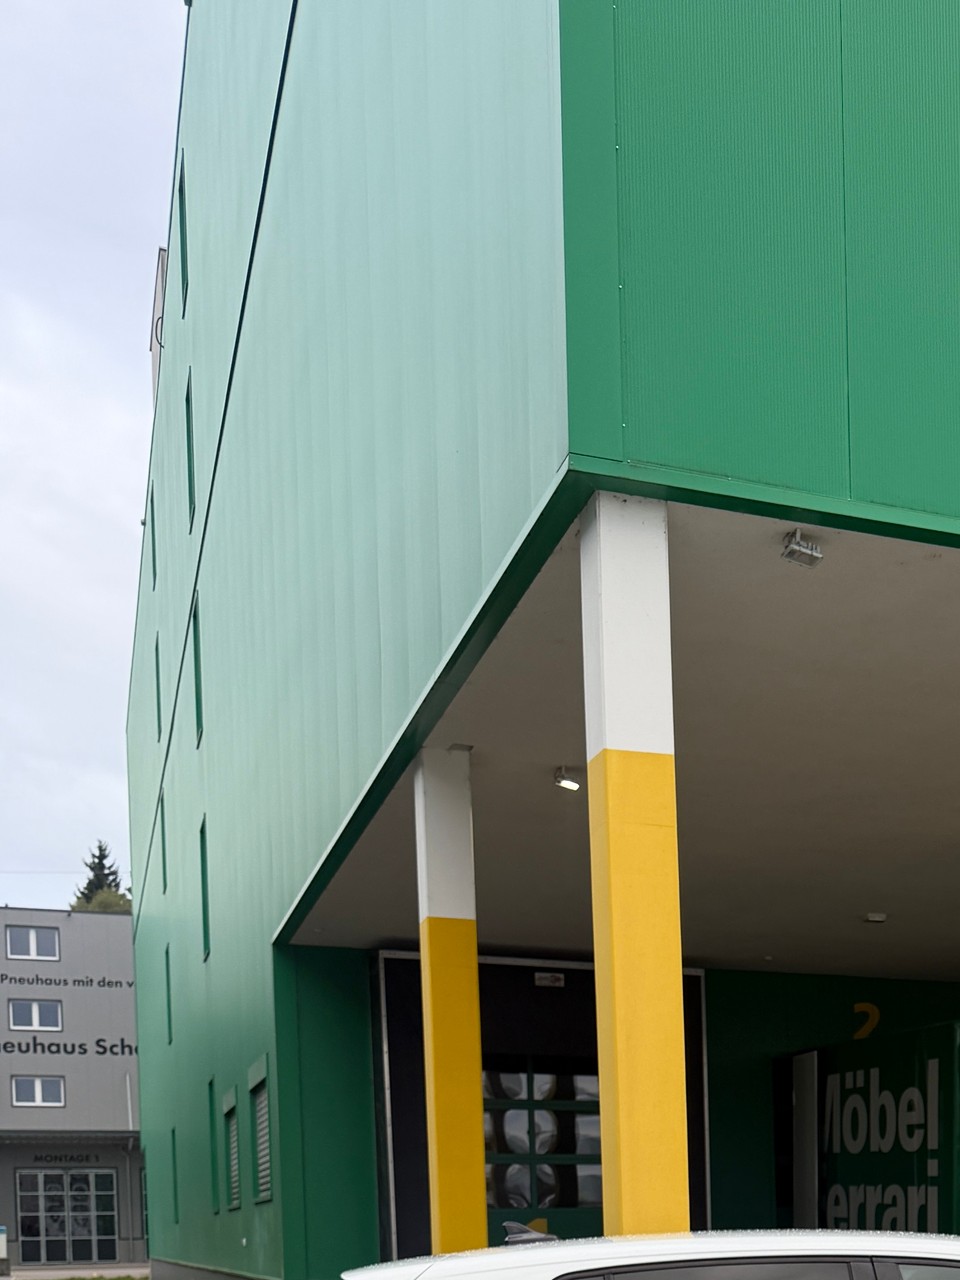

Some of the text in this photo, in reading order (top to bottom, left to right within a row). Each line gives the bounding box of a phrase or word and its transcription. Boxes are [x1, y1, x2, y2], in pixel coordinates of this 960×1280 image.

[0, 973, 68, 987] Pneuhaus
[72, 976, 94, 988] mit
[97, 977, 123, 989] den
[33, 1153, 90, 1163] MONTAGE
[826, 1159, 939, 1234] errari
